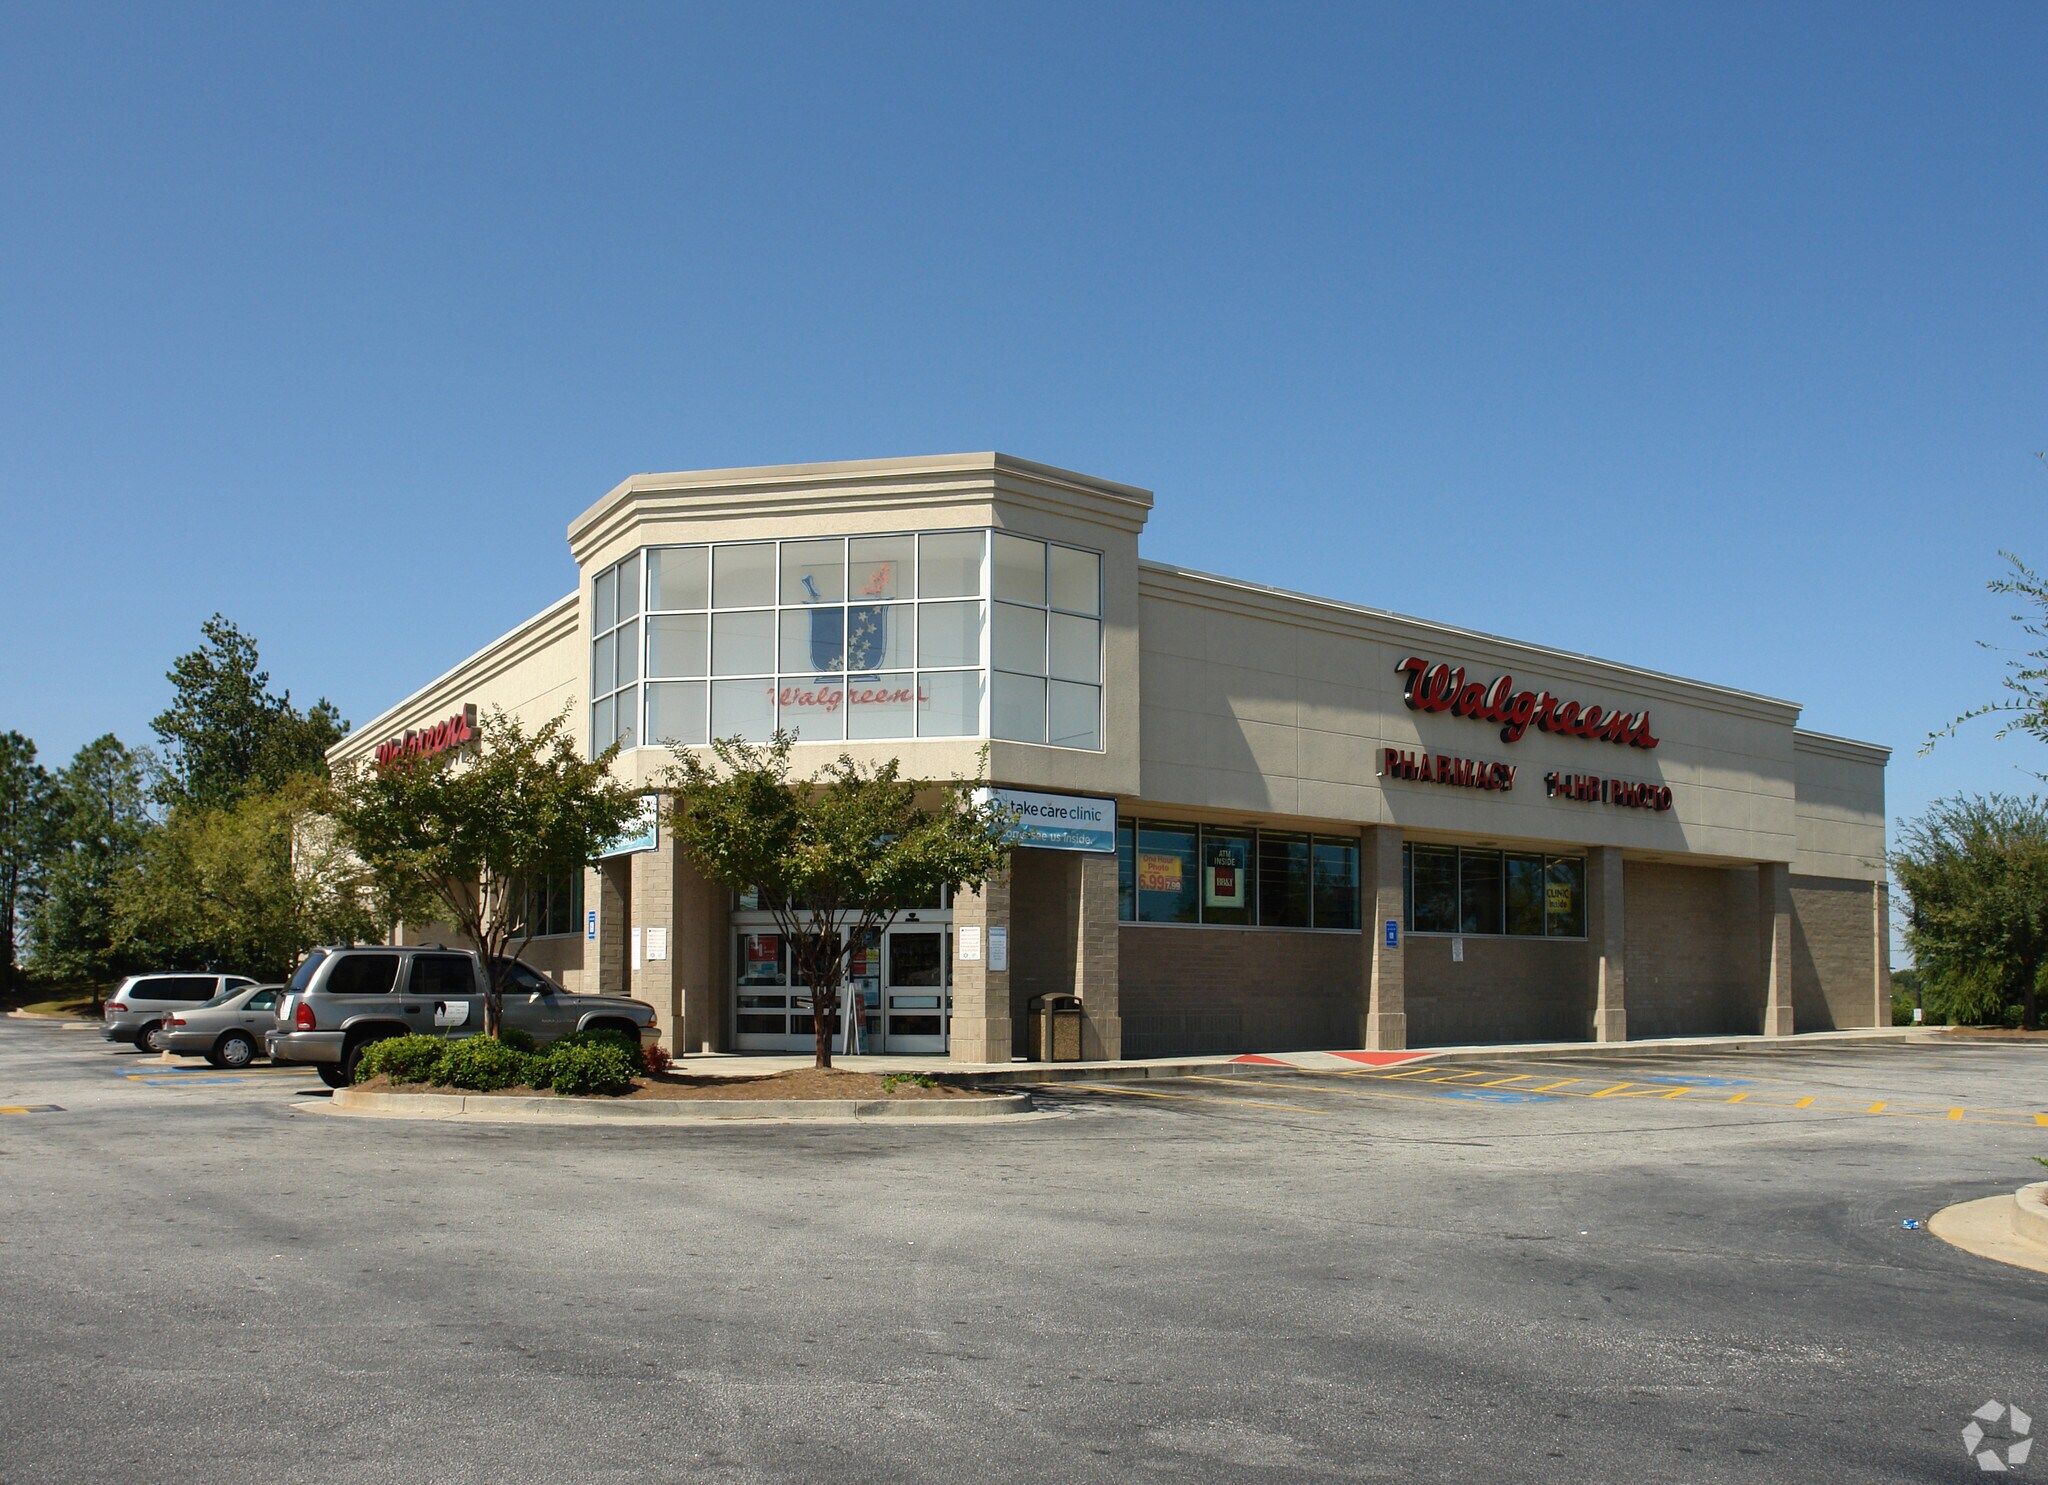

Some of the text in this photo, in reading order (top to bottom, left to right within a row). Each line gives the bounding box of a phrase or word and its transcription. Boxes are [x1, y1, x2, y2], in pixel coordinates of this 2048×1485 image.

[767, 686, 930, 712] Walgreens
[1395, 656, 1660, 750] Walgreens
[1382, 748, 1518, 791] PHARMACY
[1609, 779, 1673, 811] PHOTO
[1010, 800, 1102, 822] take care clinic
[1050, 832, 1061, 842] us
[1143, 854, 1156, 863] One
[1218, 849, 1231, 858] ATM
[1148, 863, 1170, 872] Photo
[1214, 857, 1236, 867] INSIDE
[1138, 873, 1181, 891] 6.99 7.99
[1547, 888, 1569, 899] CLINIC
